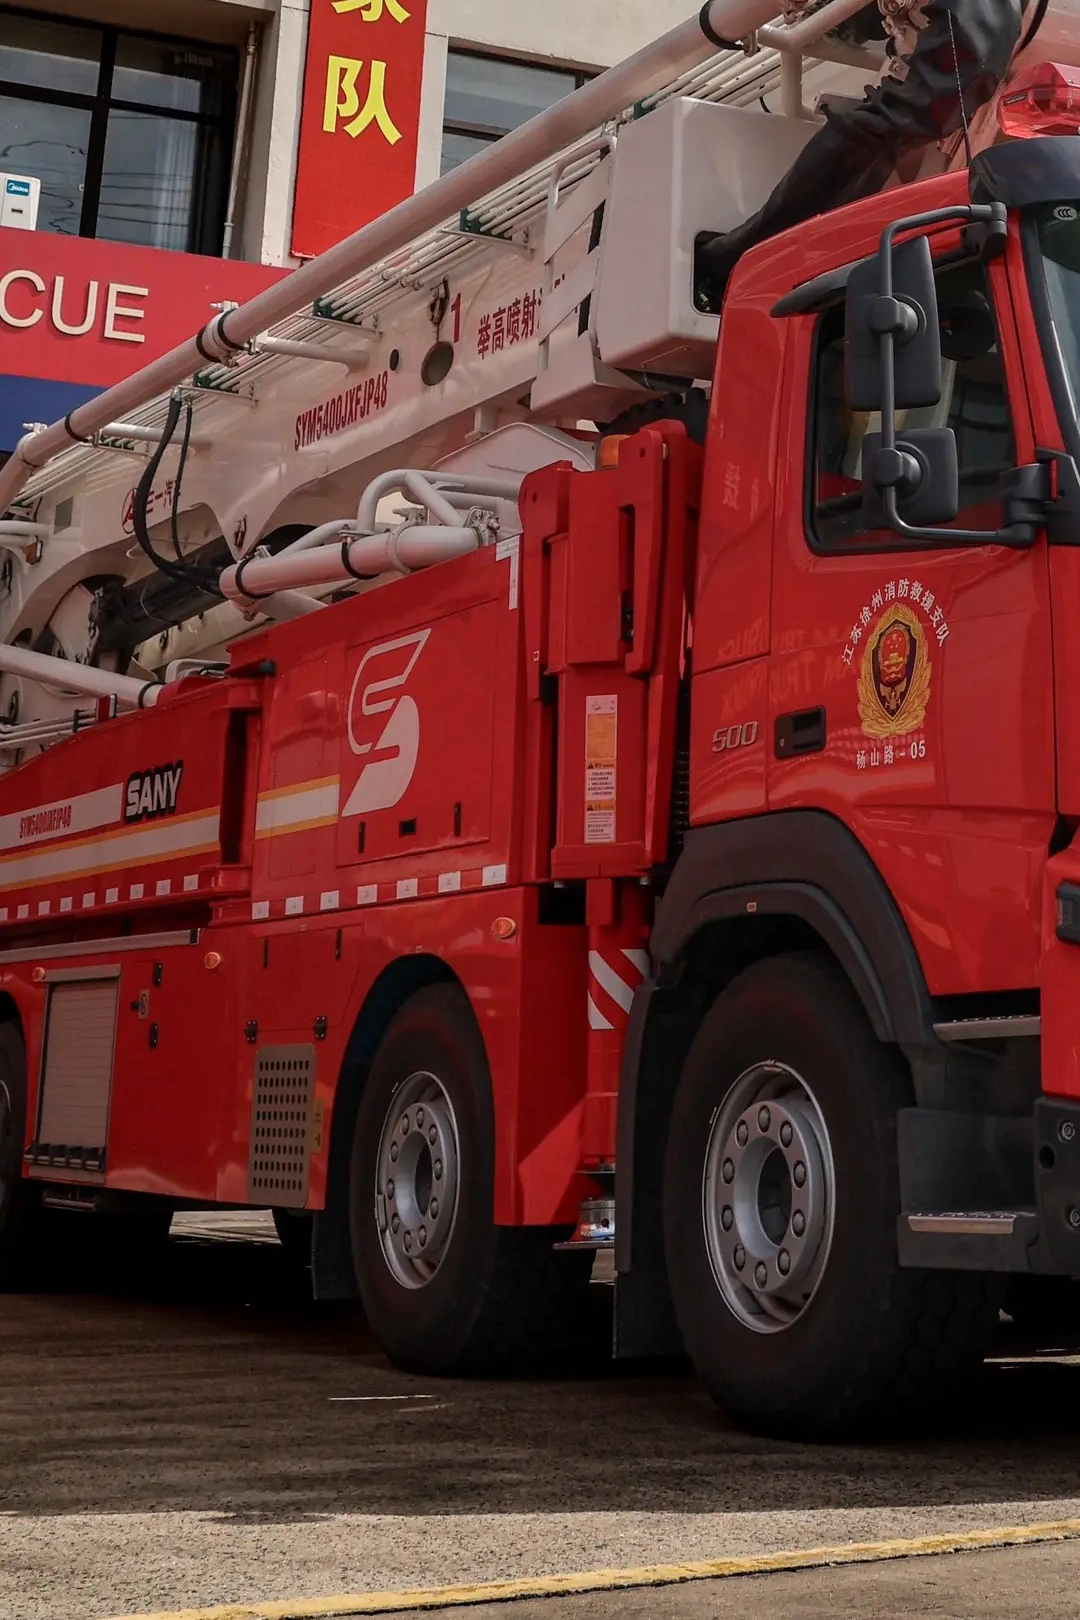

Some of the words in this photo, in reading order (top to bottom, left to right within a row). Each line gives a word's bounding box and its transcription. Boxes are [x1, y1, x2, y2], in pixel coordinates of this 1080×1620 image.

[0, 269, 149, 343] CUE
[294, 370, 387, 451] SYM5400JXFJP48
[842, 578, 950, 666] 江苏徐州消防救援支队
[712, 721, 758, 752] 500
[125, 765, 182, 818] SANY
